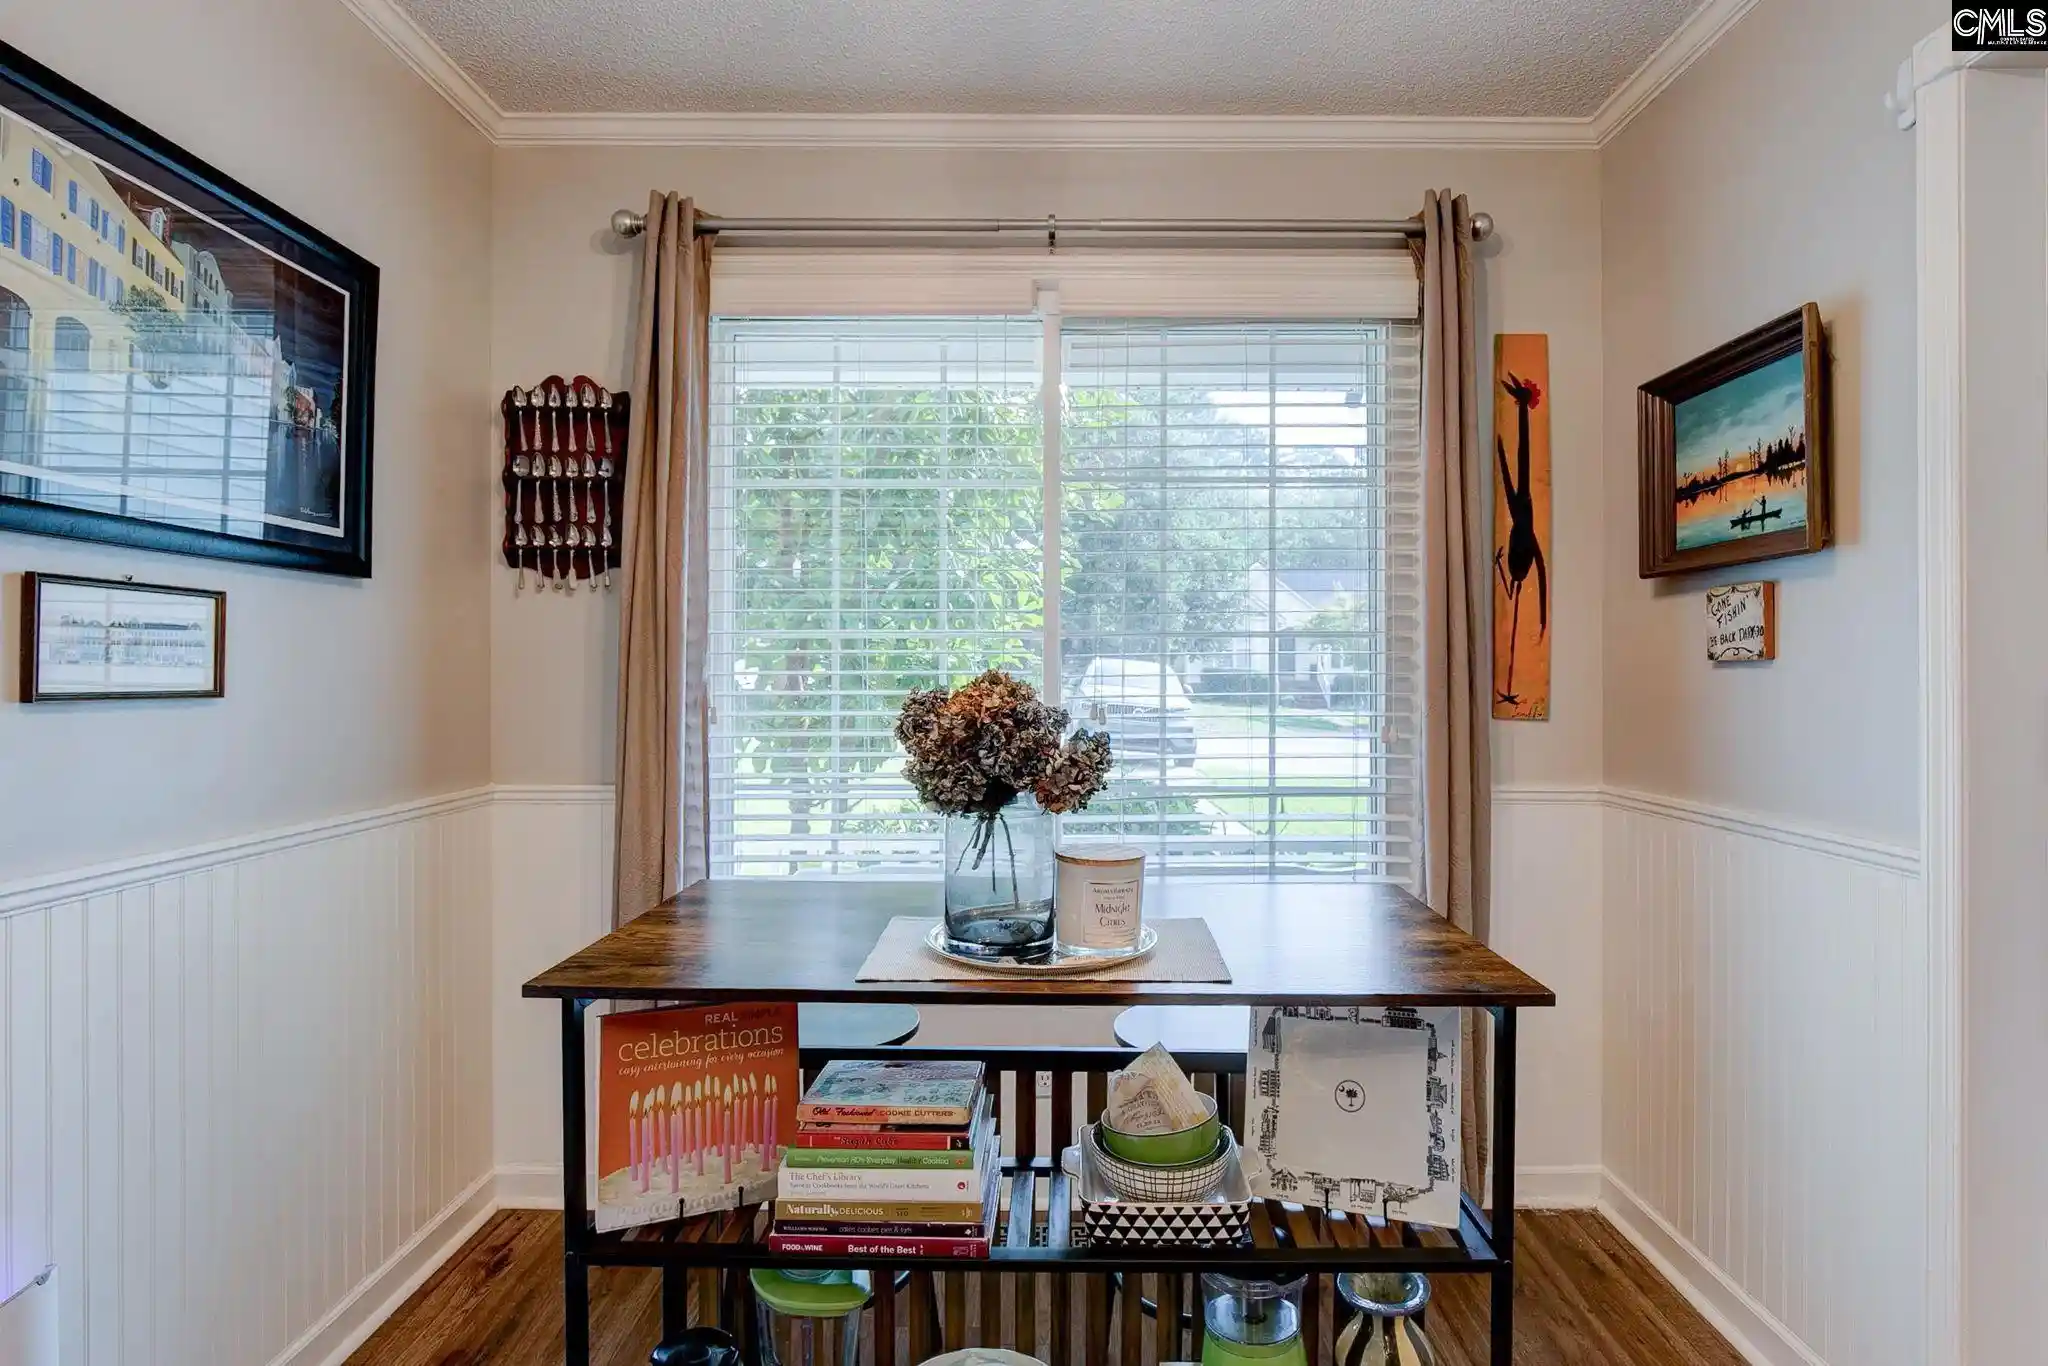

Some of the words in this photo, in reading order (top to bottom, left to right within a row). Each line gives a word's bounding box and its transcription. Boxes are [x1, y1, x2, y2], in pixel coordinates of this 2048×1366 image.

[1711, 595, 1732, 617] GONE
[1719, 631, 1737, 646] BACK
[704, 1011, 739, 1026] REAL
[618, 1023, 785, 1062] celebrations
[618, 1065, 641, 1079] easy
[643, 1056, 702, 1072] entertaining
[705, 1052, 718, 1069] for
[720, 1051, 745, 1065] every
[747, 1047, 784, 1060] occasion
[879, 1109, 912, 1117] COOKIE
[914, 1109, 954, 1118] CUTTERS
[788, 1171, 805, 1181] The
[805, 1171, 832, 1181] Chef's
[833, 1171, 862, 1183] Library
[839, 1207, 885, 1216] DELICIOUS
[847, 1243, 868, 1254] Best
[869, 1244, 879, 1254] of
[880, 1244, 895, 1255] the
[896, 1245, 917, 1255] Best
